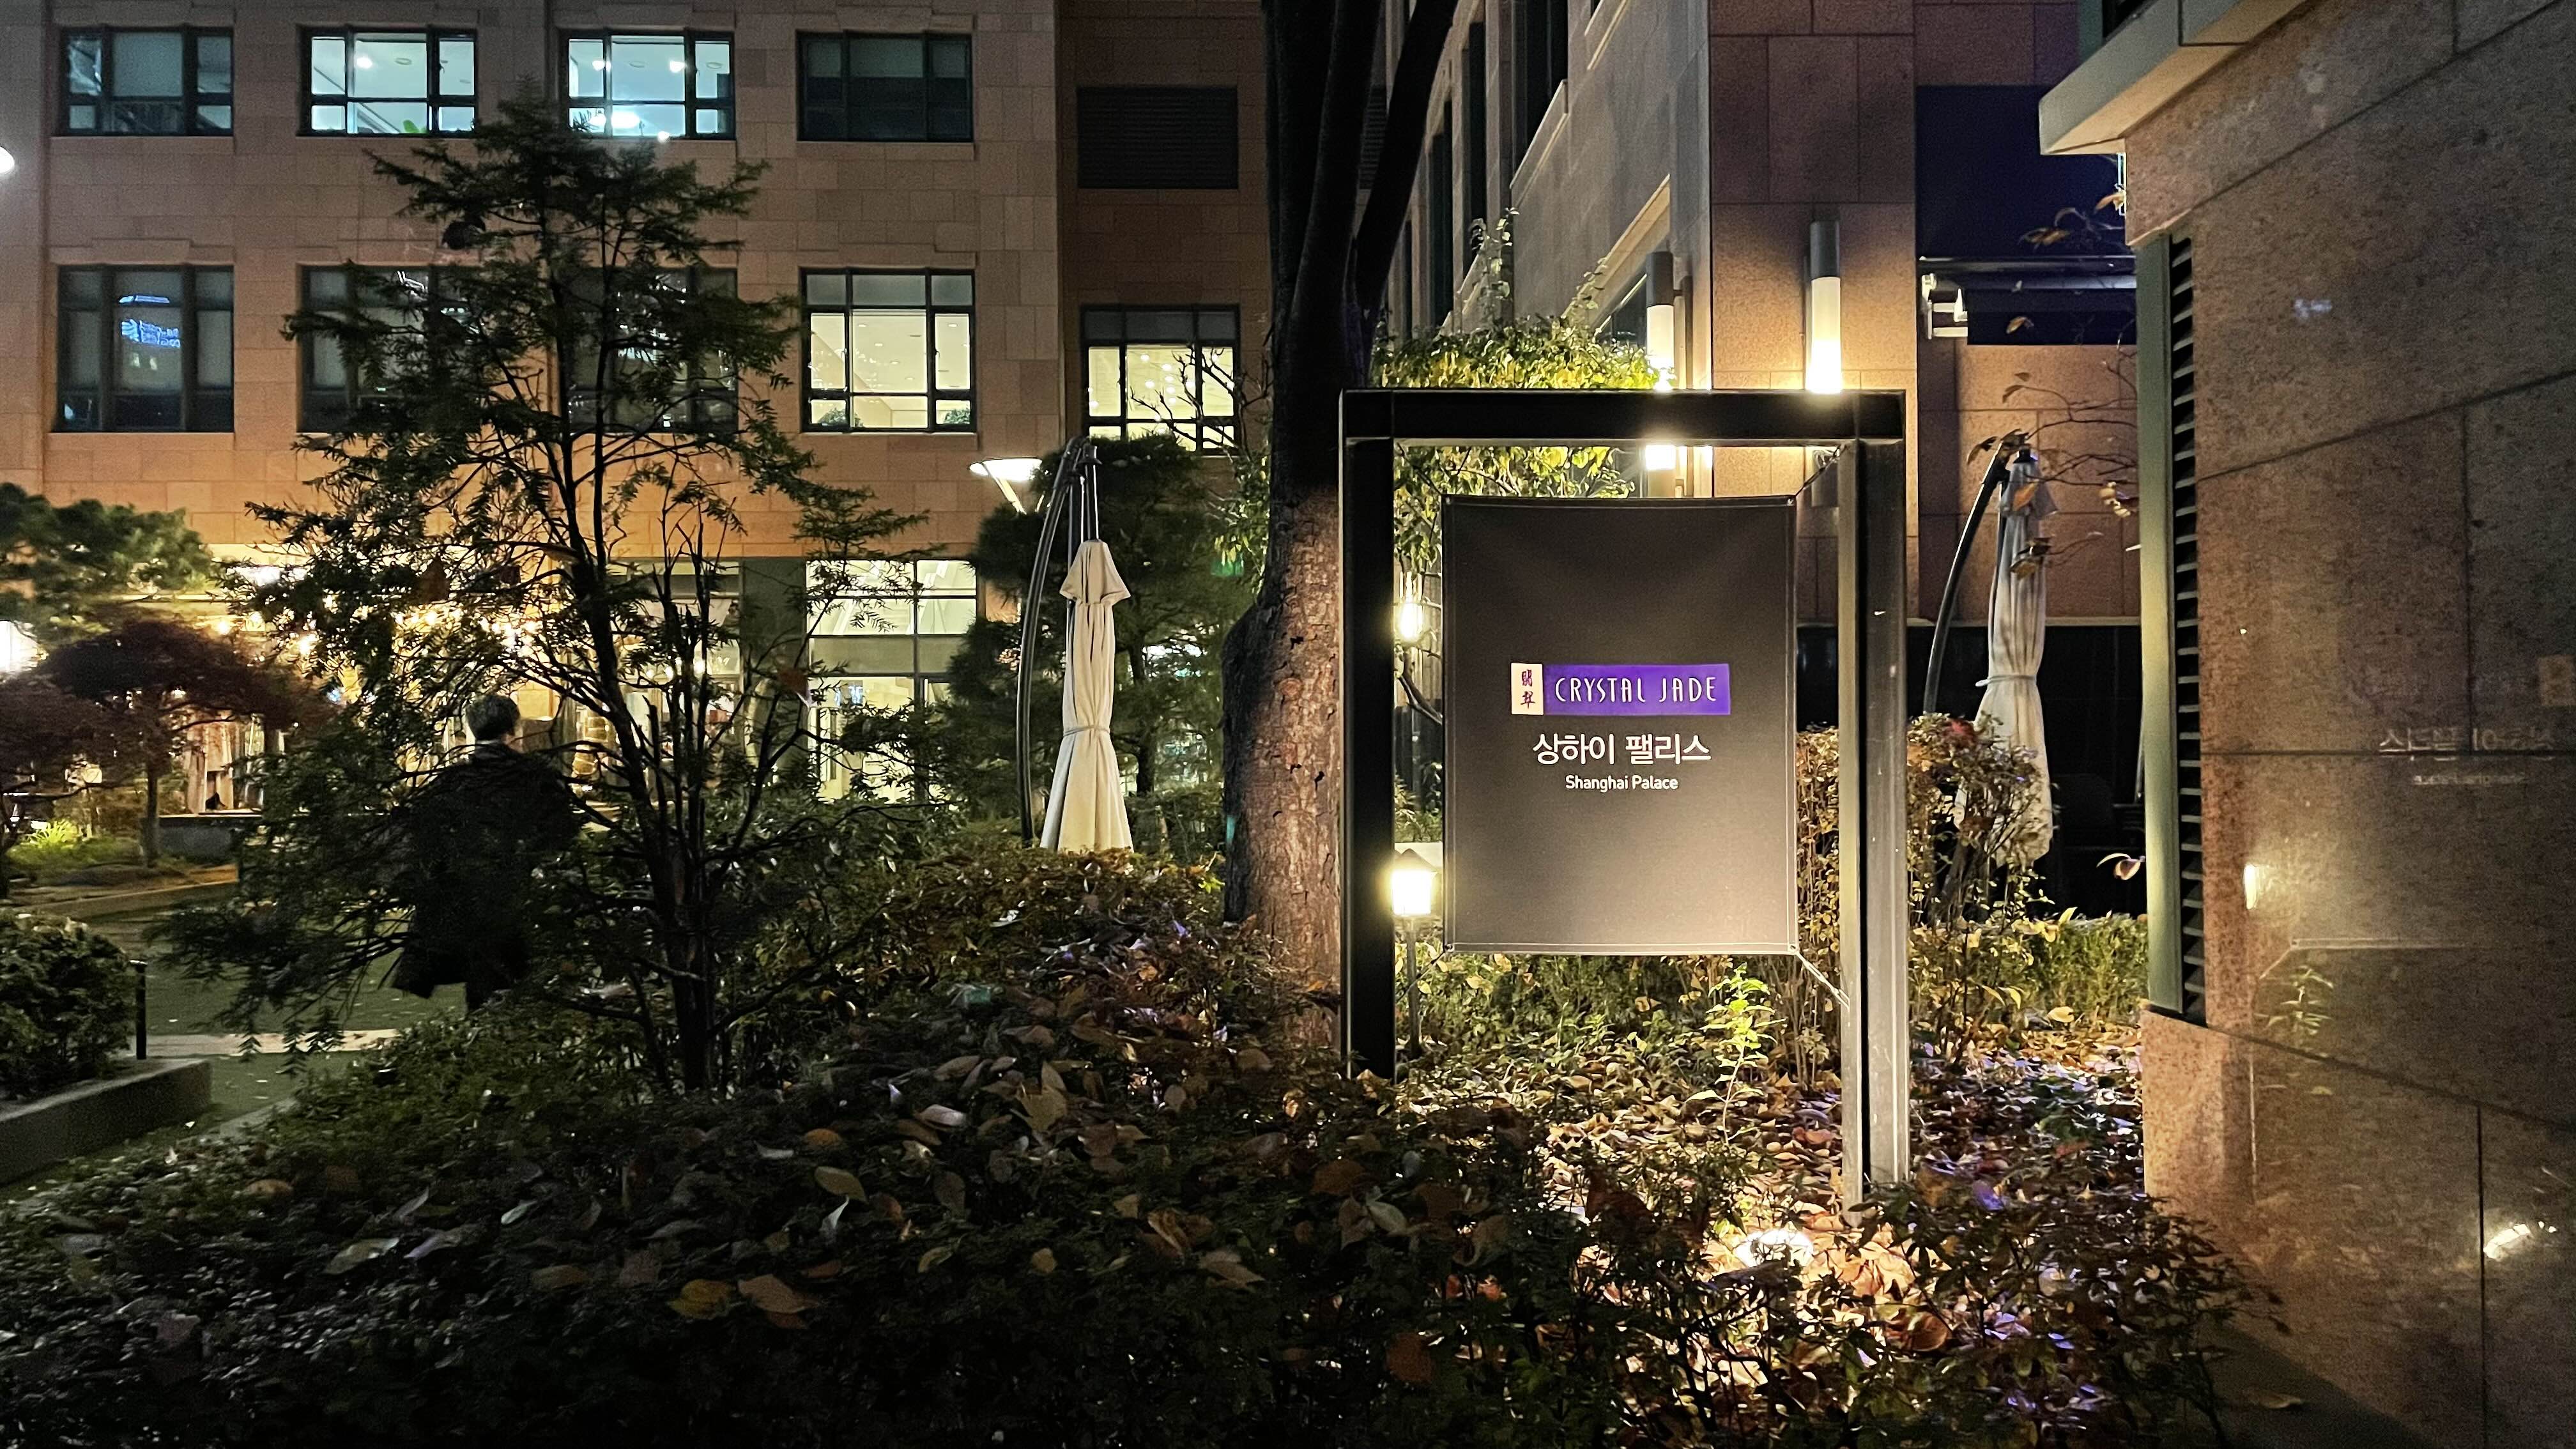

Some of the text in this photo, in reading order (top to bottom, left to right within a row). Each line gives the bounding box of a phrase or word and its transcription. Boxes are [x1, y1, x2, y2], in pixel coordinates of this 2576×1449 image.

[1555, 677, 1717, 703] CRYSTAL JADE
[1533, 733, 1712, 765] 상하이 팰리스
[1565, 774, 1678, 793] Shanghai Palace
